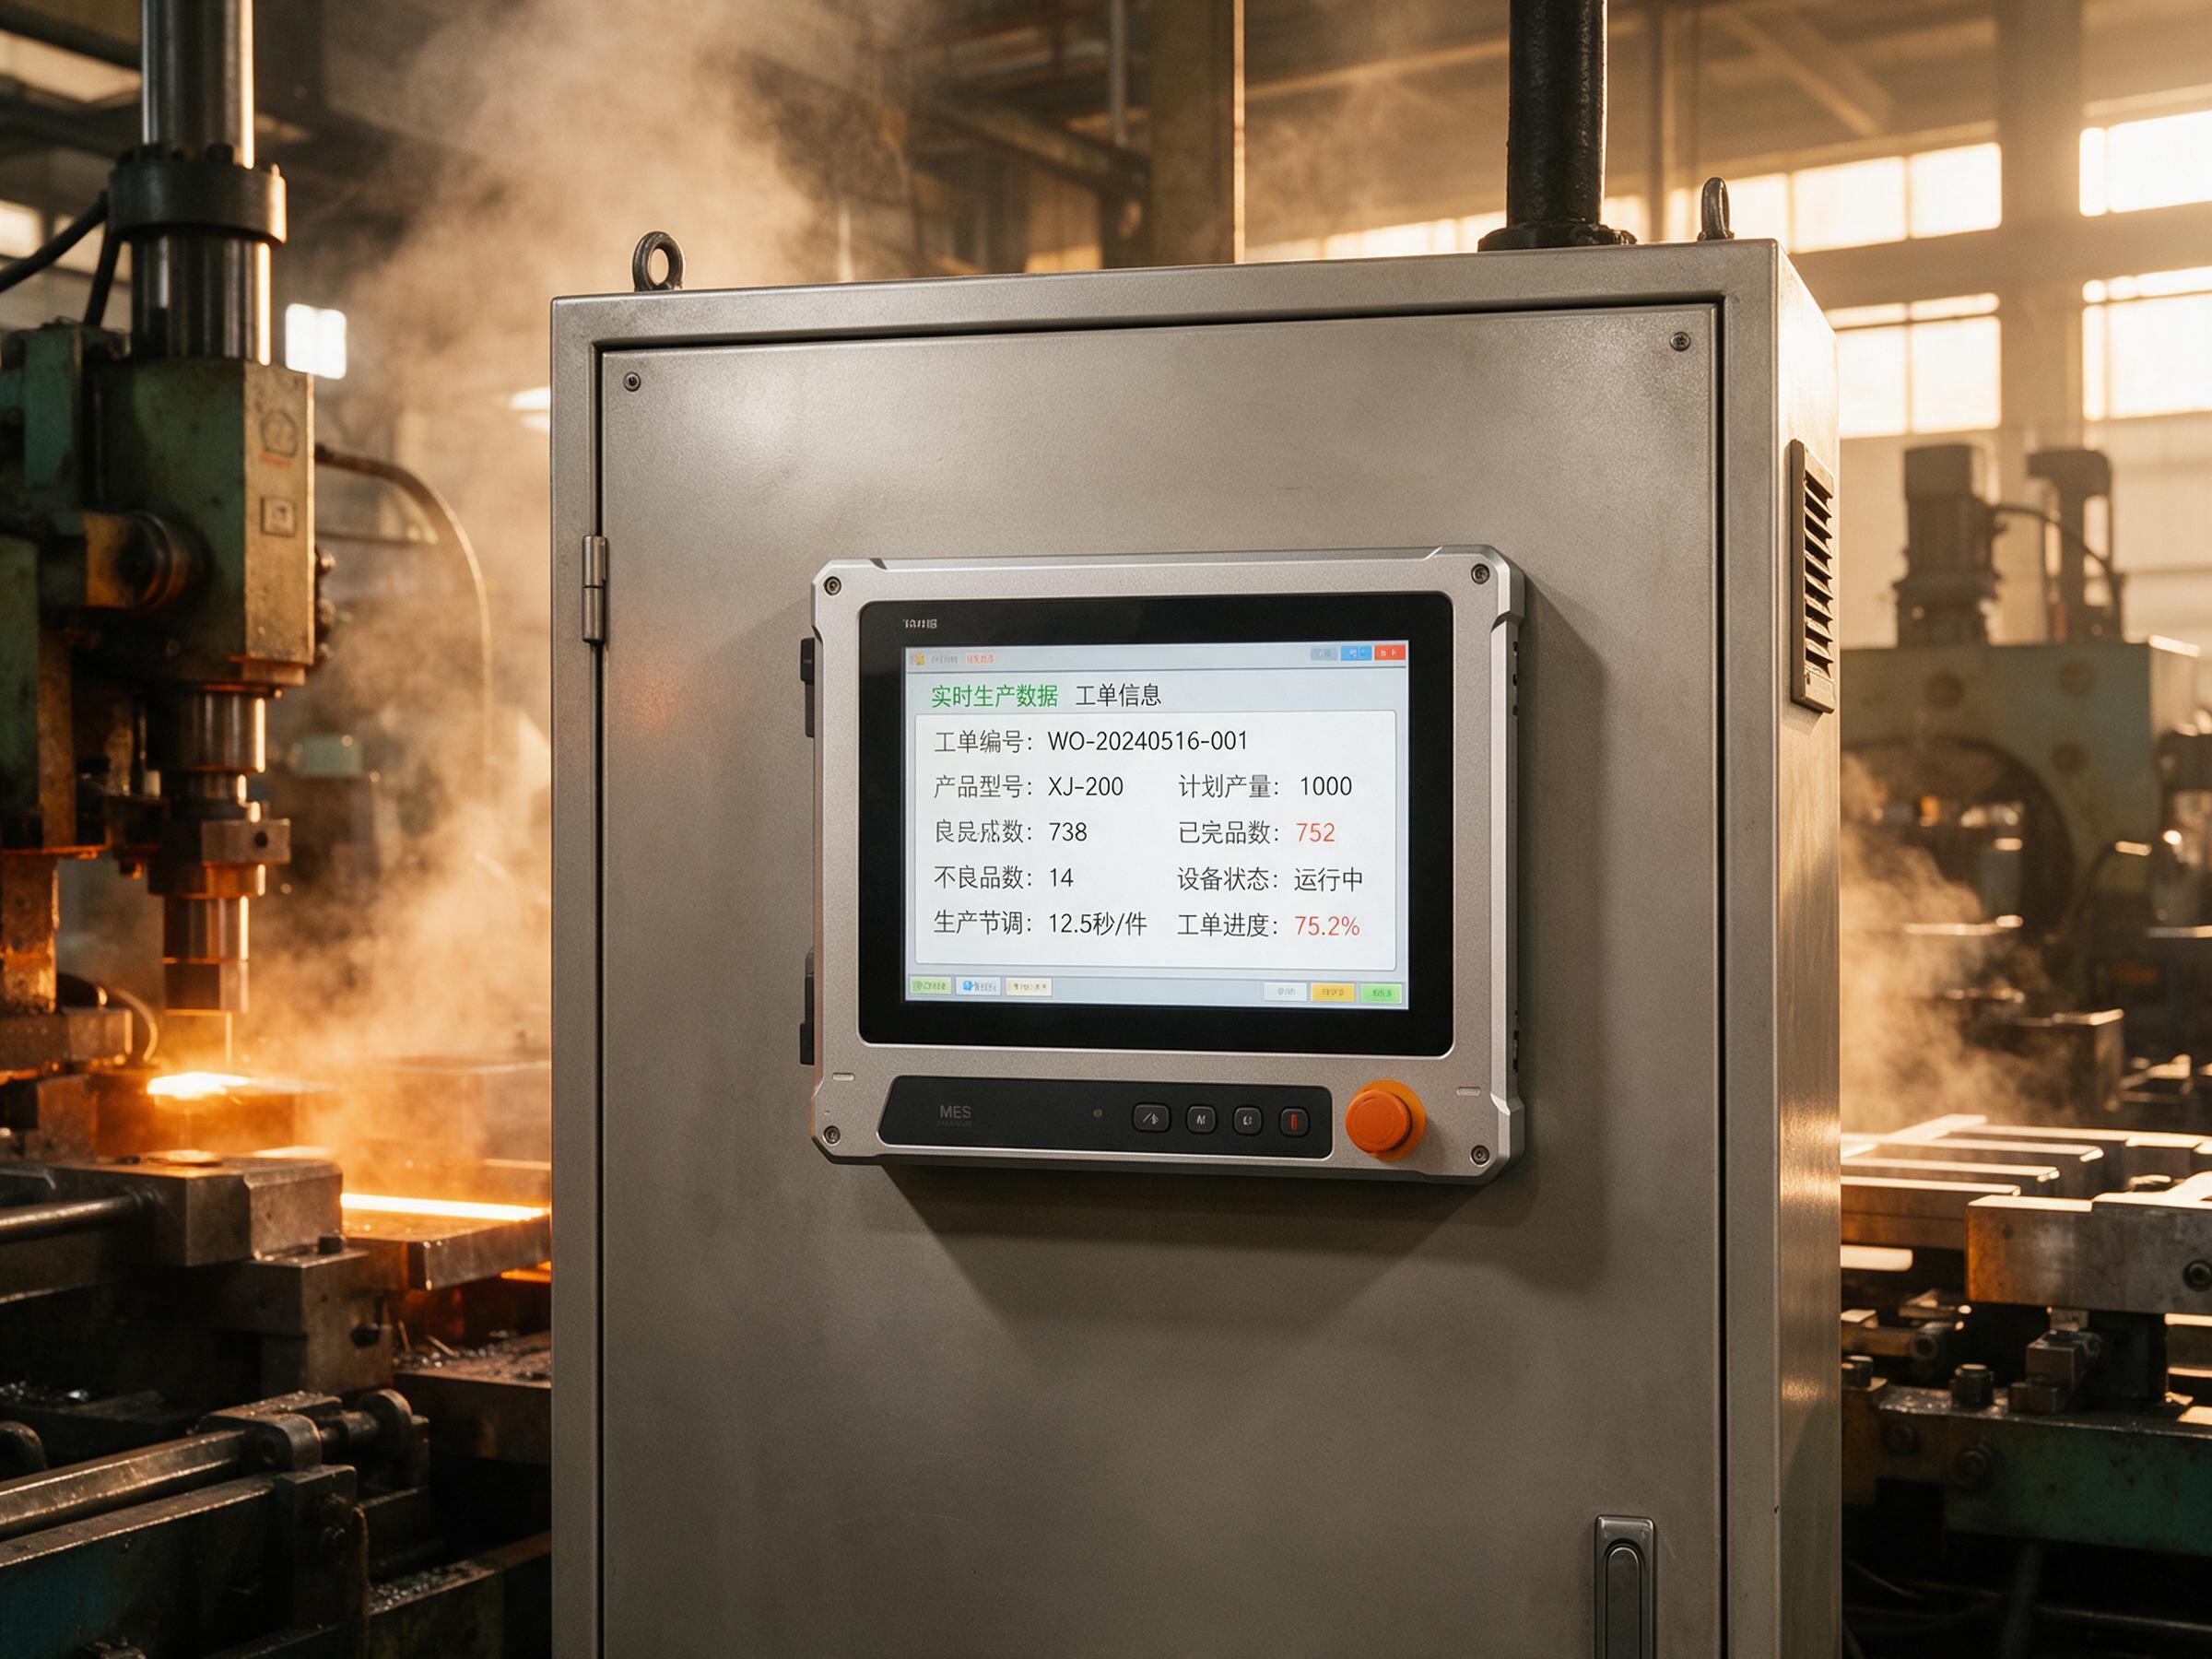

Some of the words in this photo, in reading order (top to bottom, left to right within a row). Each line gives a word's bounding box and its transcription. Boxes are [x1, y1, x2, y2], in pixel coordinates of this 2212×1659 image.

[932, 685, 1058, 708] 实时生产数据
[1076, 683, 1161, 707] 工单信息
[1048, 731, 1245, 750] WO-20240516-001
[1048, 777, 1123, 796] XJ-200
[1301, 776, 1352, 795] 1000
[1049, 822, 1087, 841] 738
[1297, 822, 1335, 841] 752
[1051, 868, 1074, 887] 14
[1295, 867, 1362, 892] 运行中
[1050, 912, 1147, 936] 12.5秒/件
[1295, 916, 1359, 935] 75.2%
[939, 1105, 971, 1119] MES
